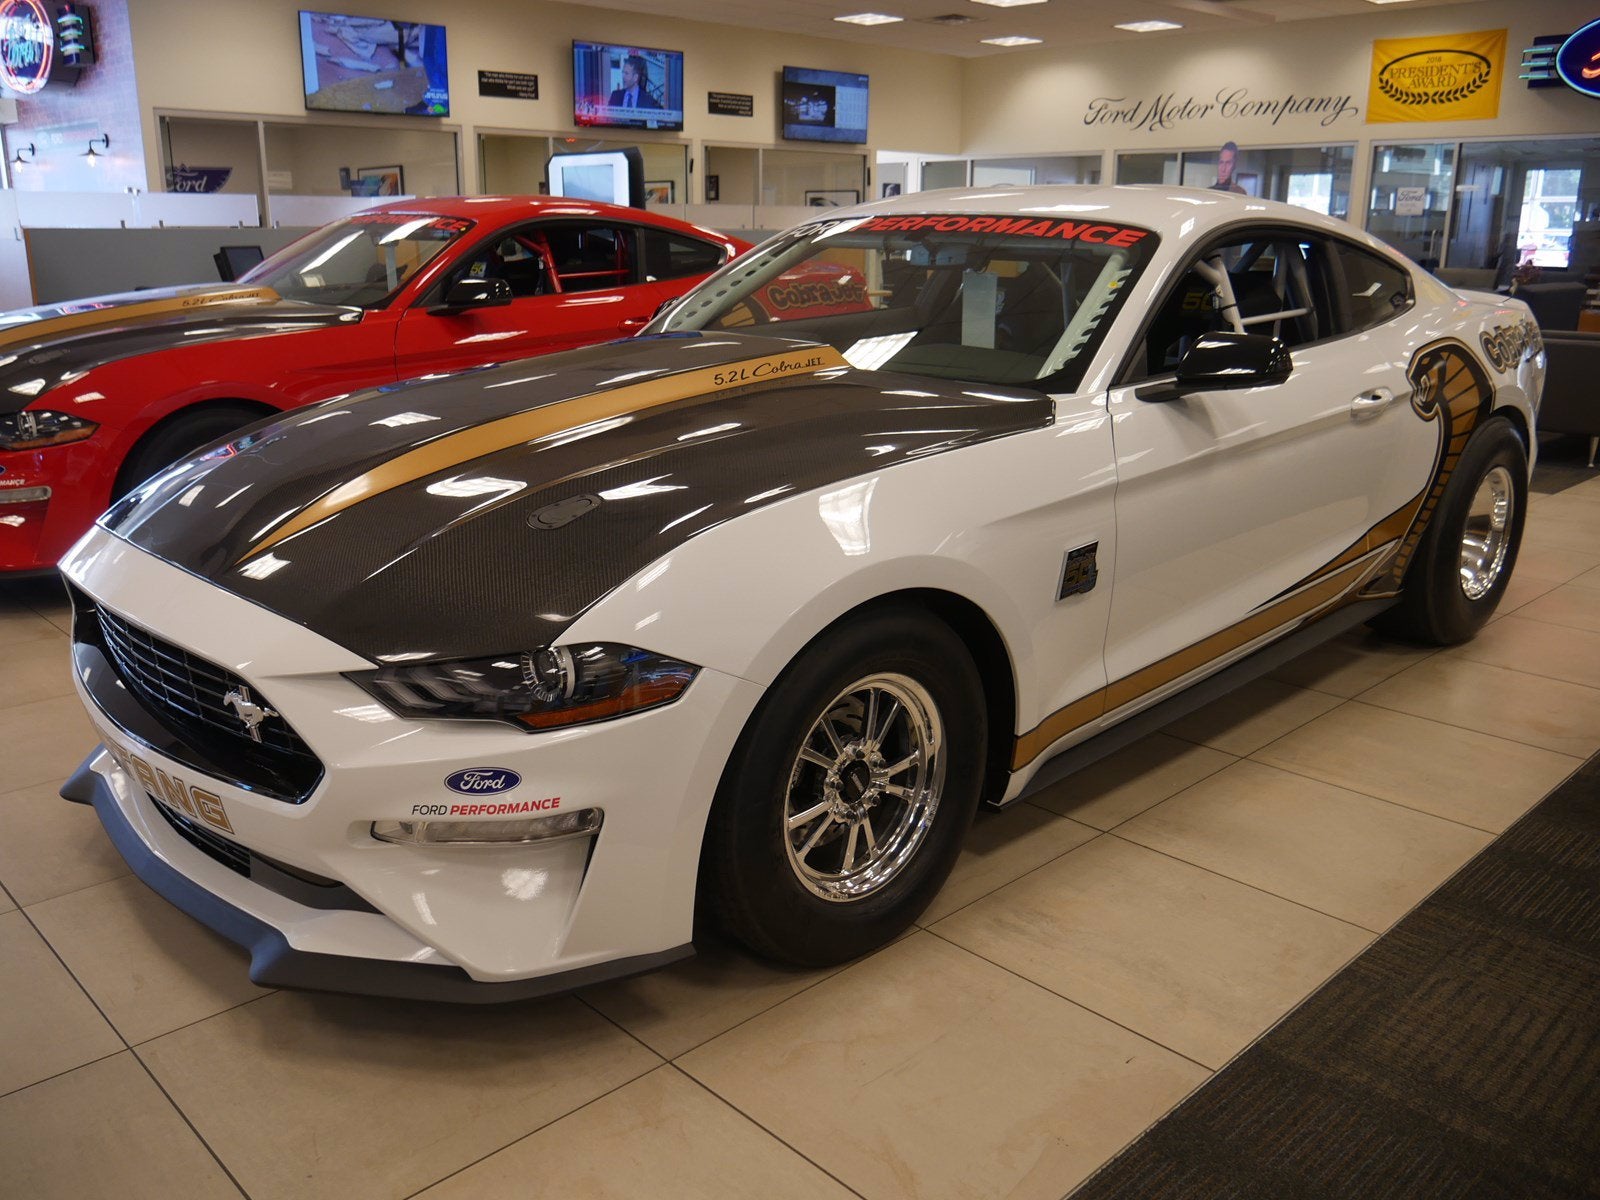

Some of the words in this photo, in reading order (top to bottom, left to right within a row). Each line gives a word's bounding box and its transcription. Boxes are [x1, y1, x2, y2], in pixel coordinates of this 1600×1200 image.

[1389, 61, 1482, 79] PRESIDENT'S
[1408, 75, 1457, 89] AWARD
[1083, 96, 1142, 131] Ford
[1130, 92, 1214, 132] Motor
[1215, 87, 1359, 127] Company
[850, 215, 1149, 248] PERFORMANCE
[714, 368, 750, 386] 5.2L
[752, 360, 802, 377] Cobra
[805, 356, 825, 368] JET
[459, 771, 506, 791] Ford
[411, 804, 448, 816] FORD
[449, 797, 561, 816] PERFORMANCE
